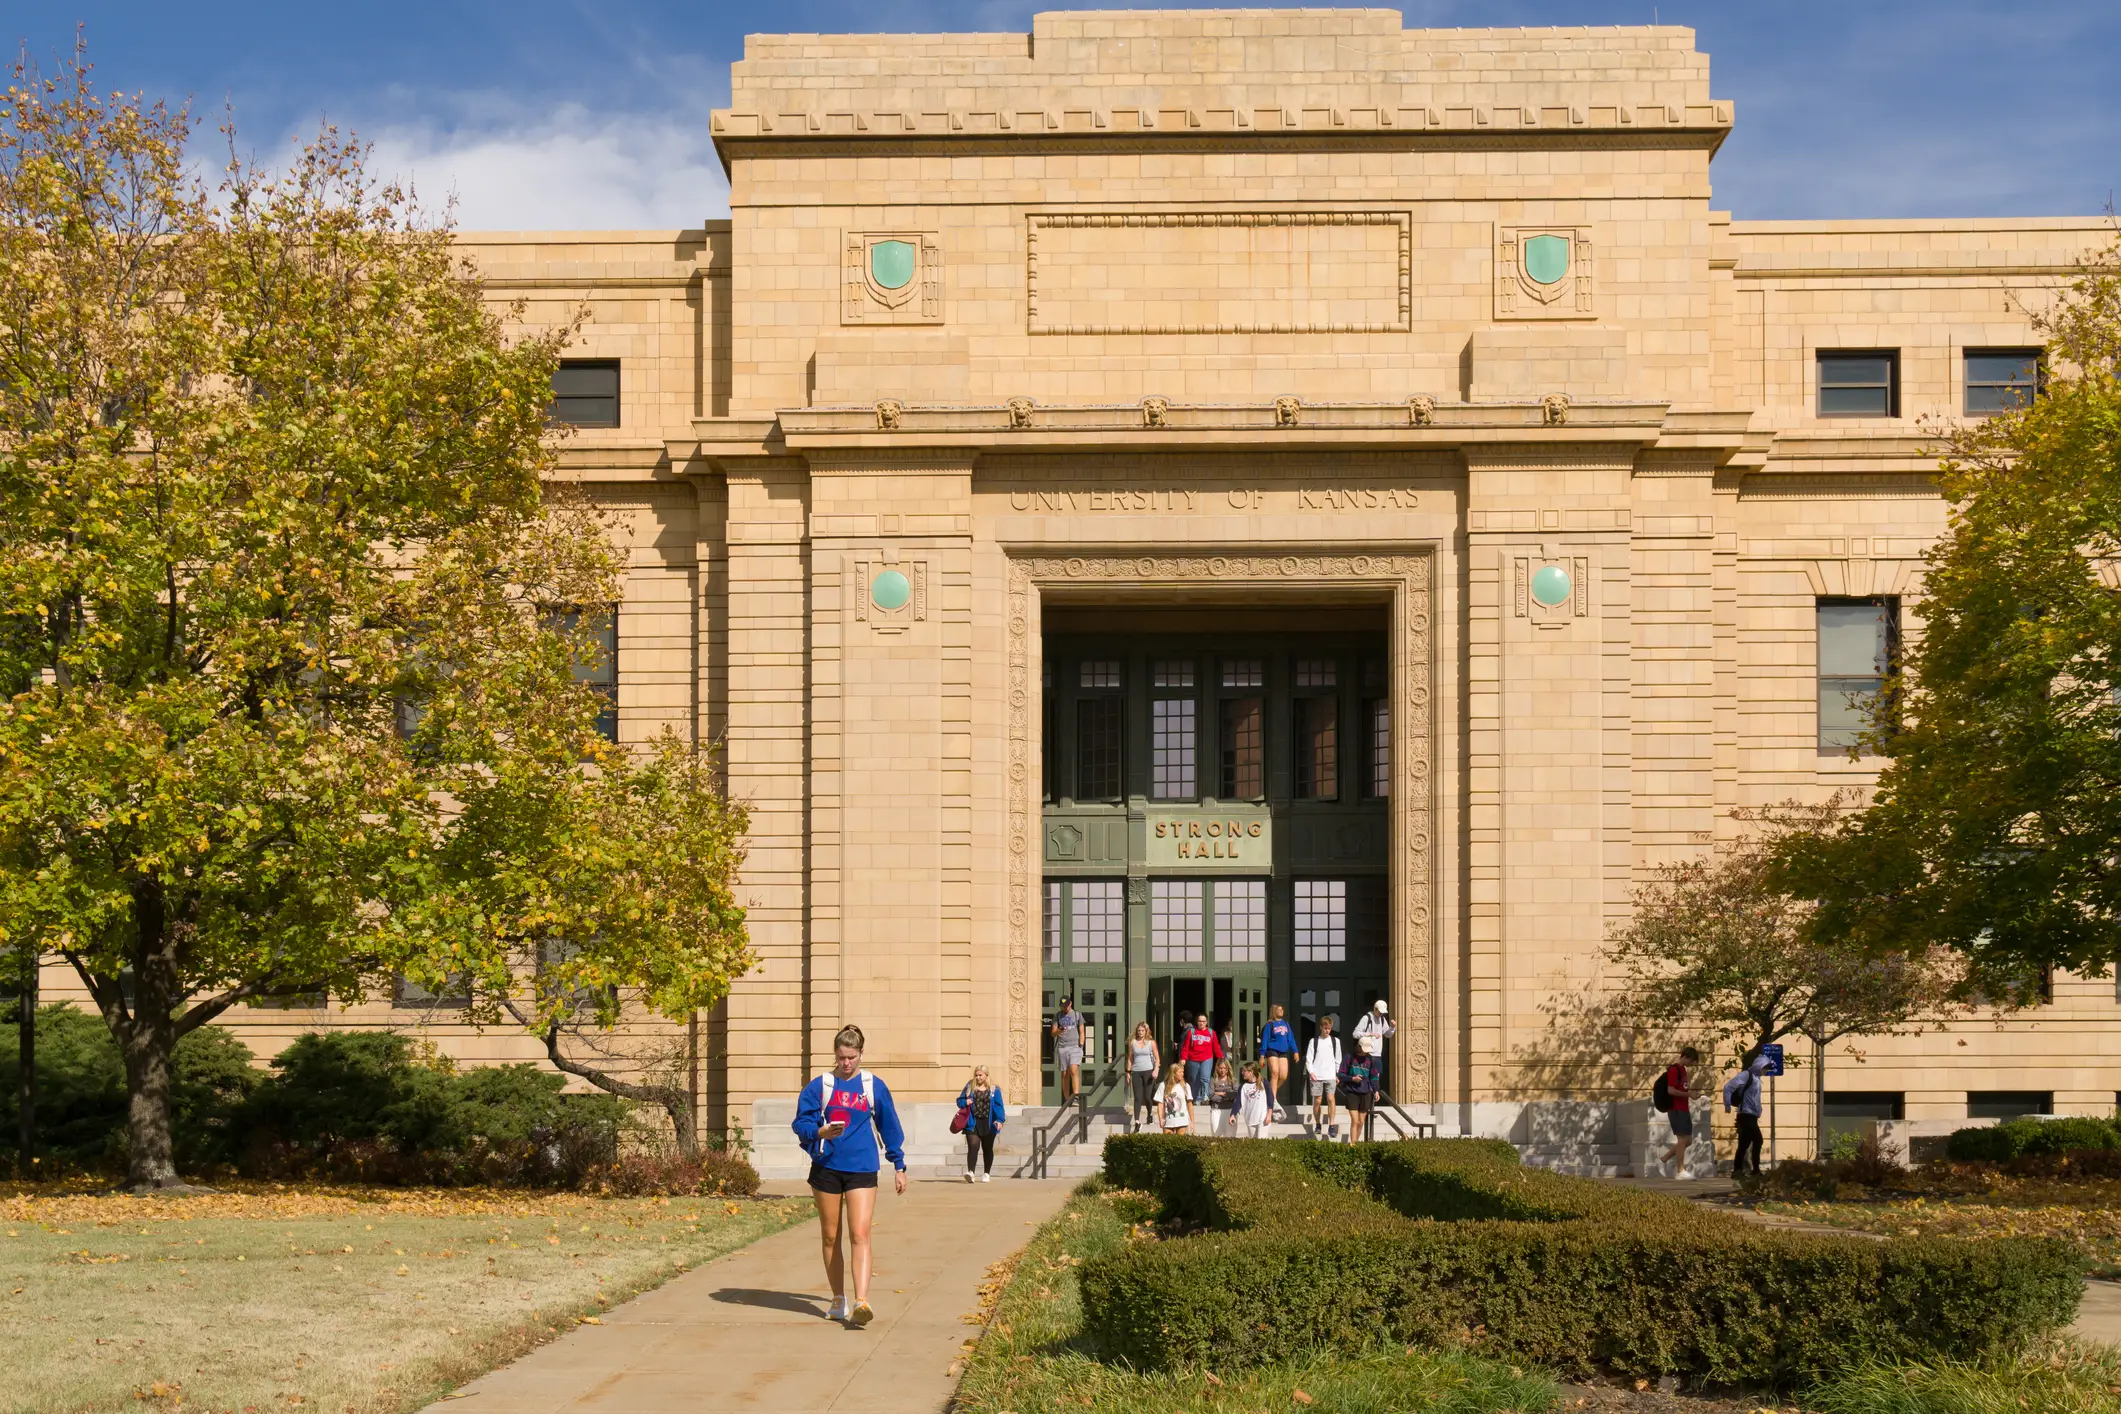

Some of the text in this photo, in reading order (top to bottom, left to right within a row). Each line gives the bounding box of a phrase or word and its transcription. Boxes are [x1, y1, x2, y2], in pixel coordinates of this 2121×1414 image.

[1010, 485, 1420, 512] UNIVERSITY OF KANSAS
[1155, 820, 1262, 838] STRONG
[1177, 841, 1239, 859] HALL
